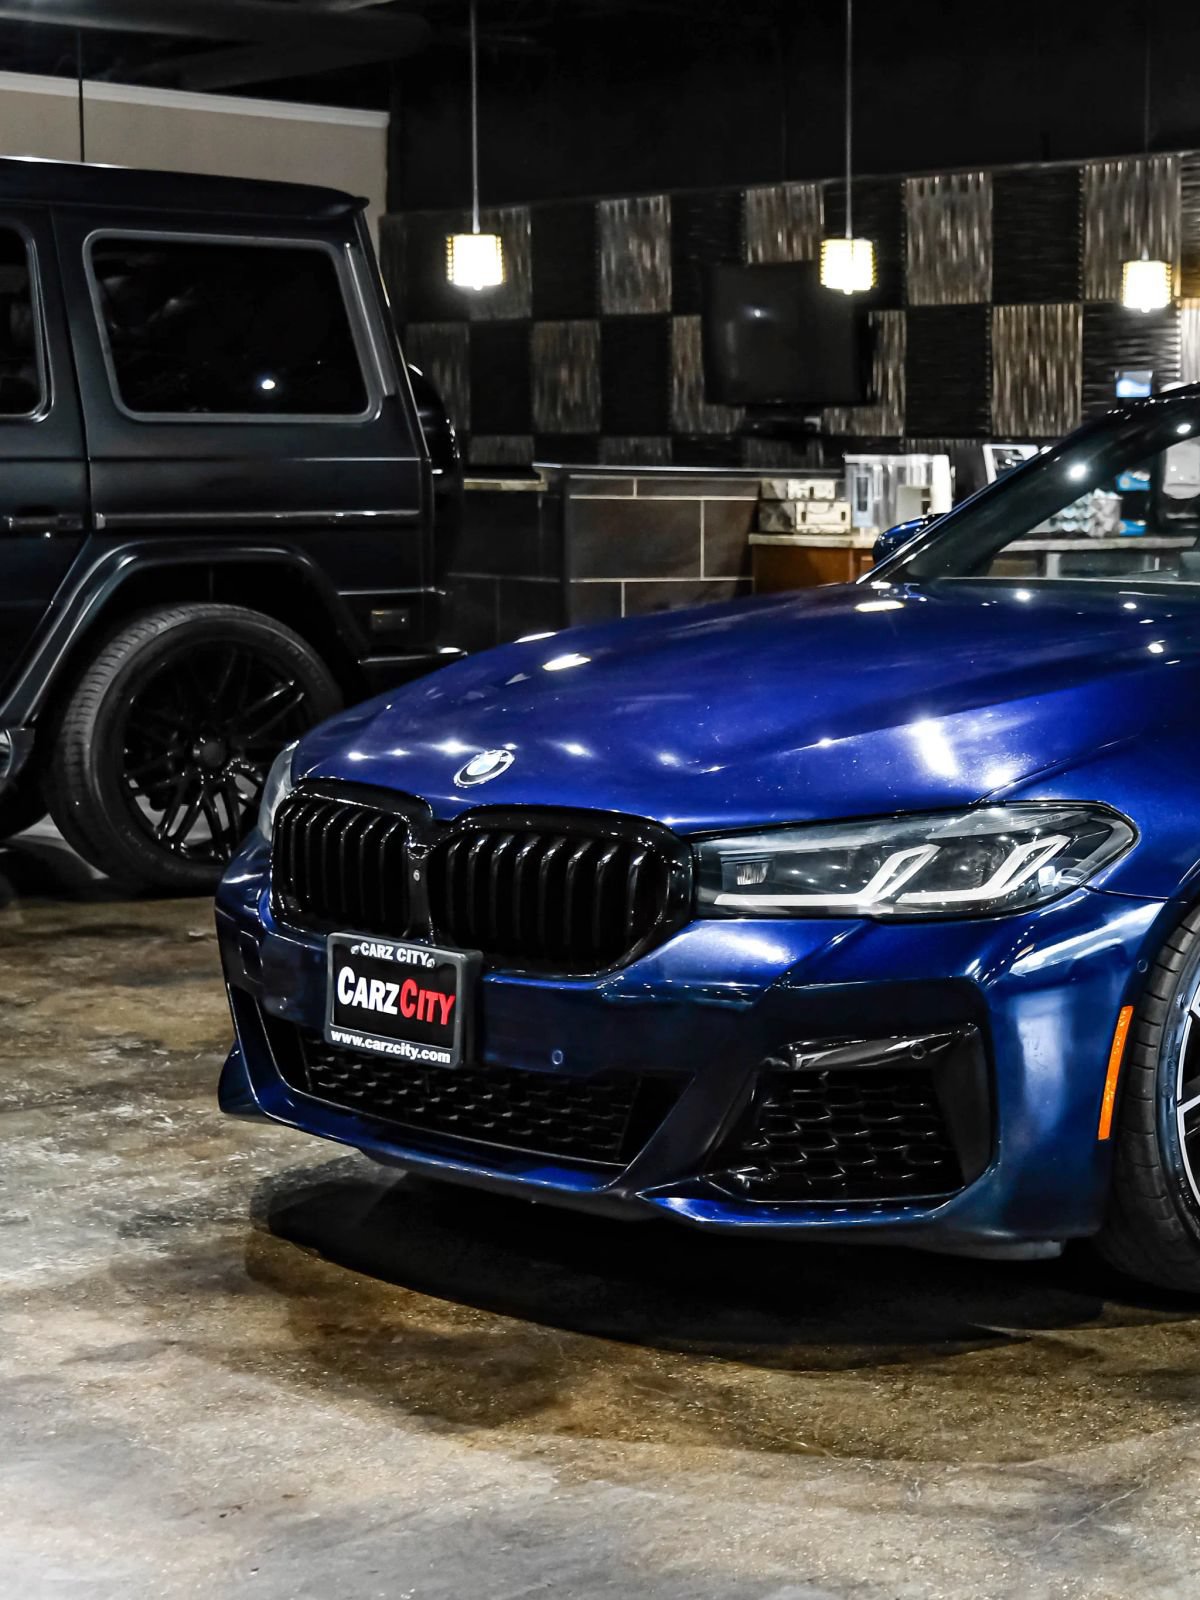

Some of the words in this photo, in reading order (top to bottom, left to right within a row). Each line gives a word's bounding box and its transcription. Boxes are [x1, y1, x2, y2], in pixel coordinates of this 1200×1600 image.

[360, 942, 393, 960] CARZ
[397, 948, 429, 966] CITY
[331, 1030, 451, 1063] www.carzcity.com
